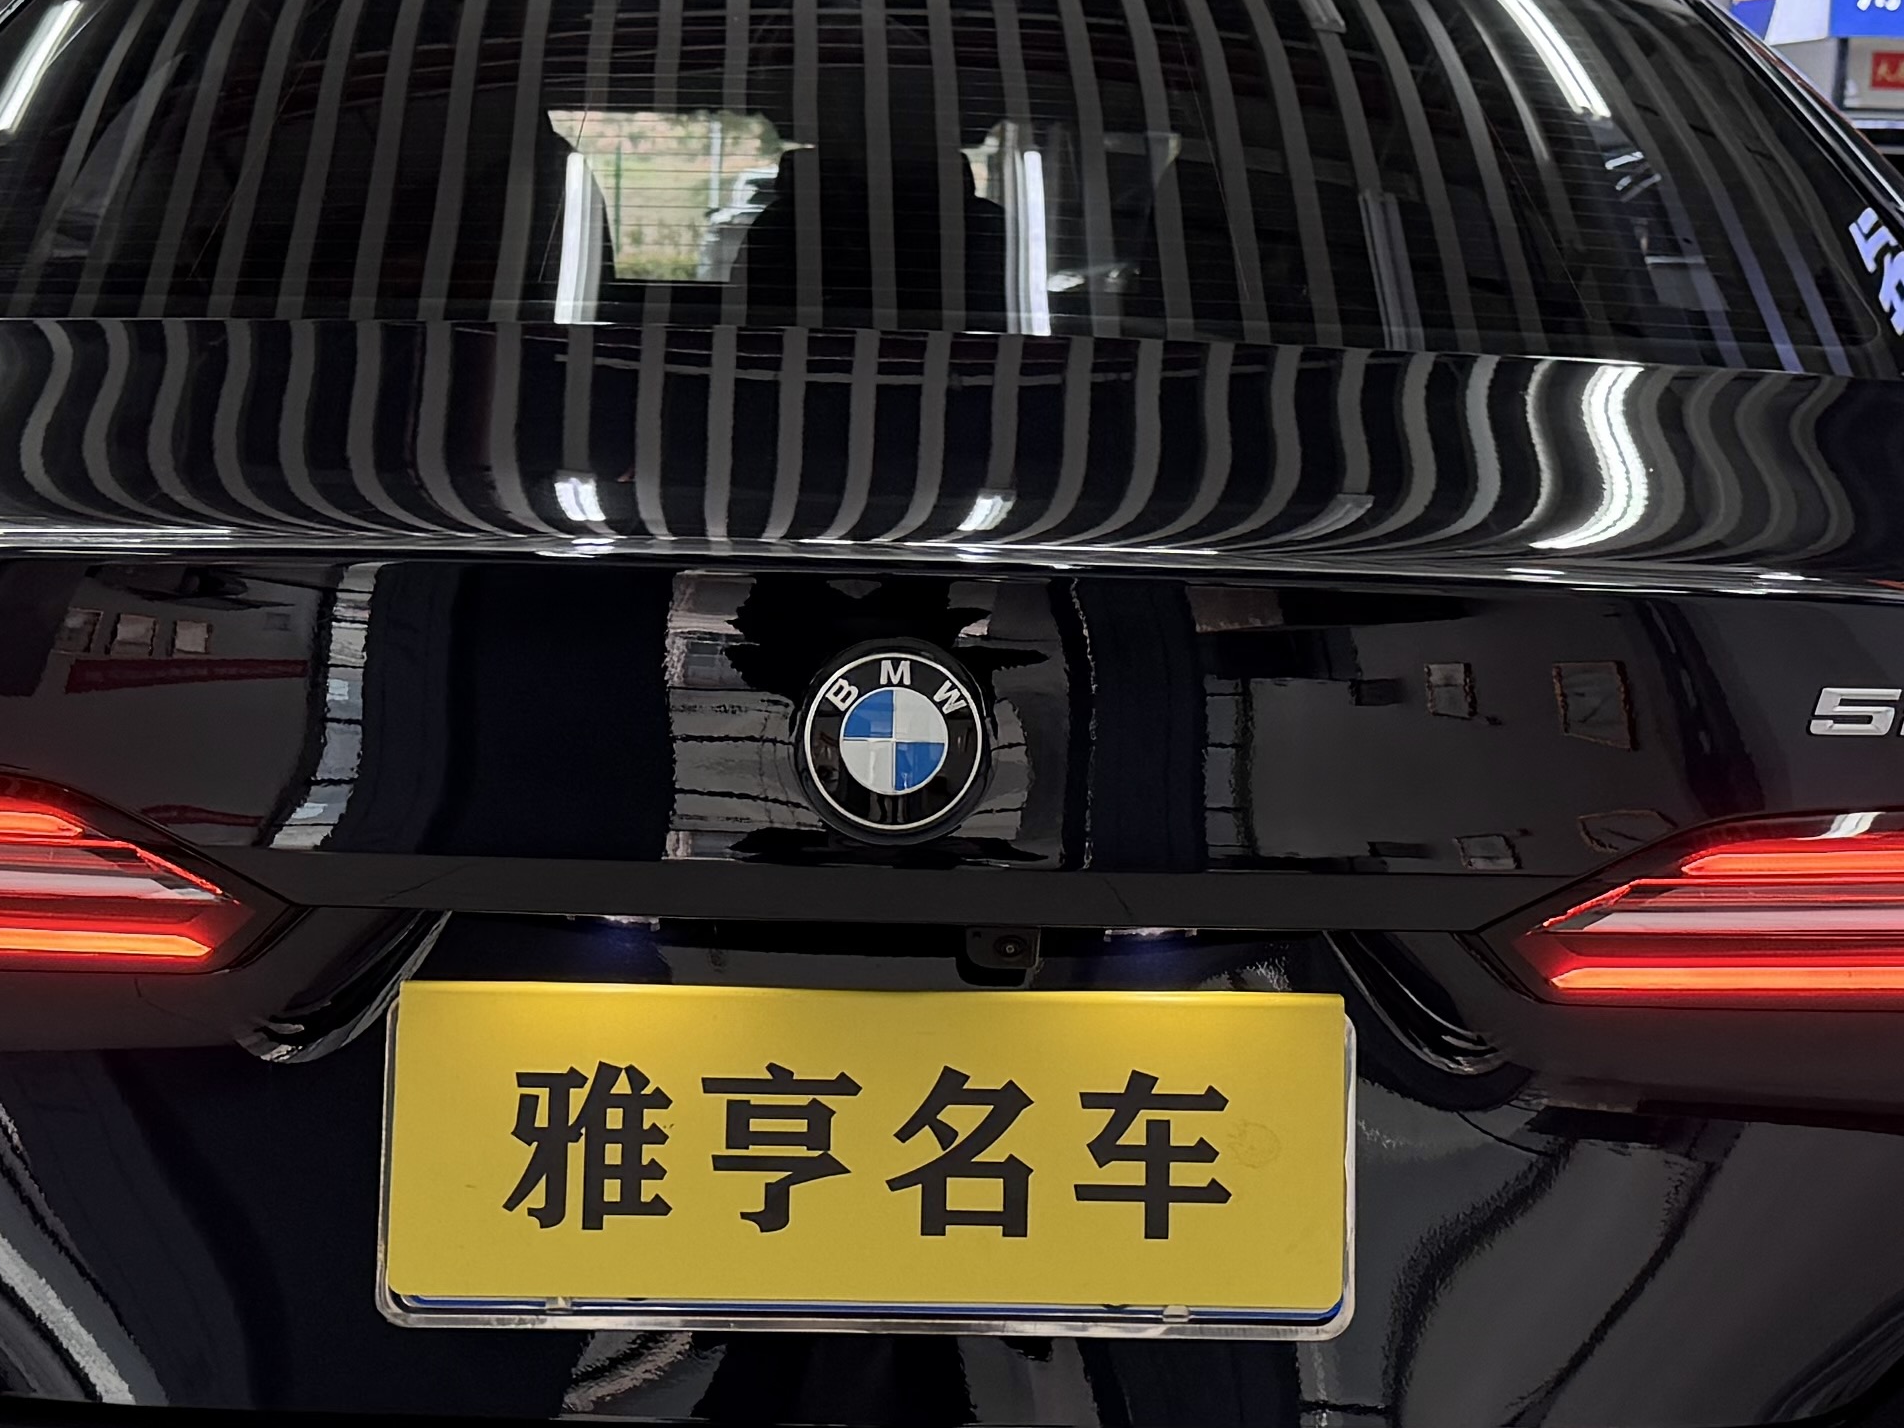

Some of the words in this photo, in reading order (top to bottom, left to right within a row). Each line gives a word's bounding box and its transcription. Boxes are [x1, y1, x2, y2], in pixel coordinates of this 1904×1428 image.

[825, 659, 969, 715] BMW
[502, 1060, 1233, 1241] 雅亨名车
